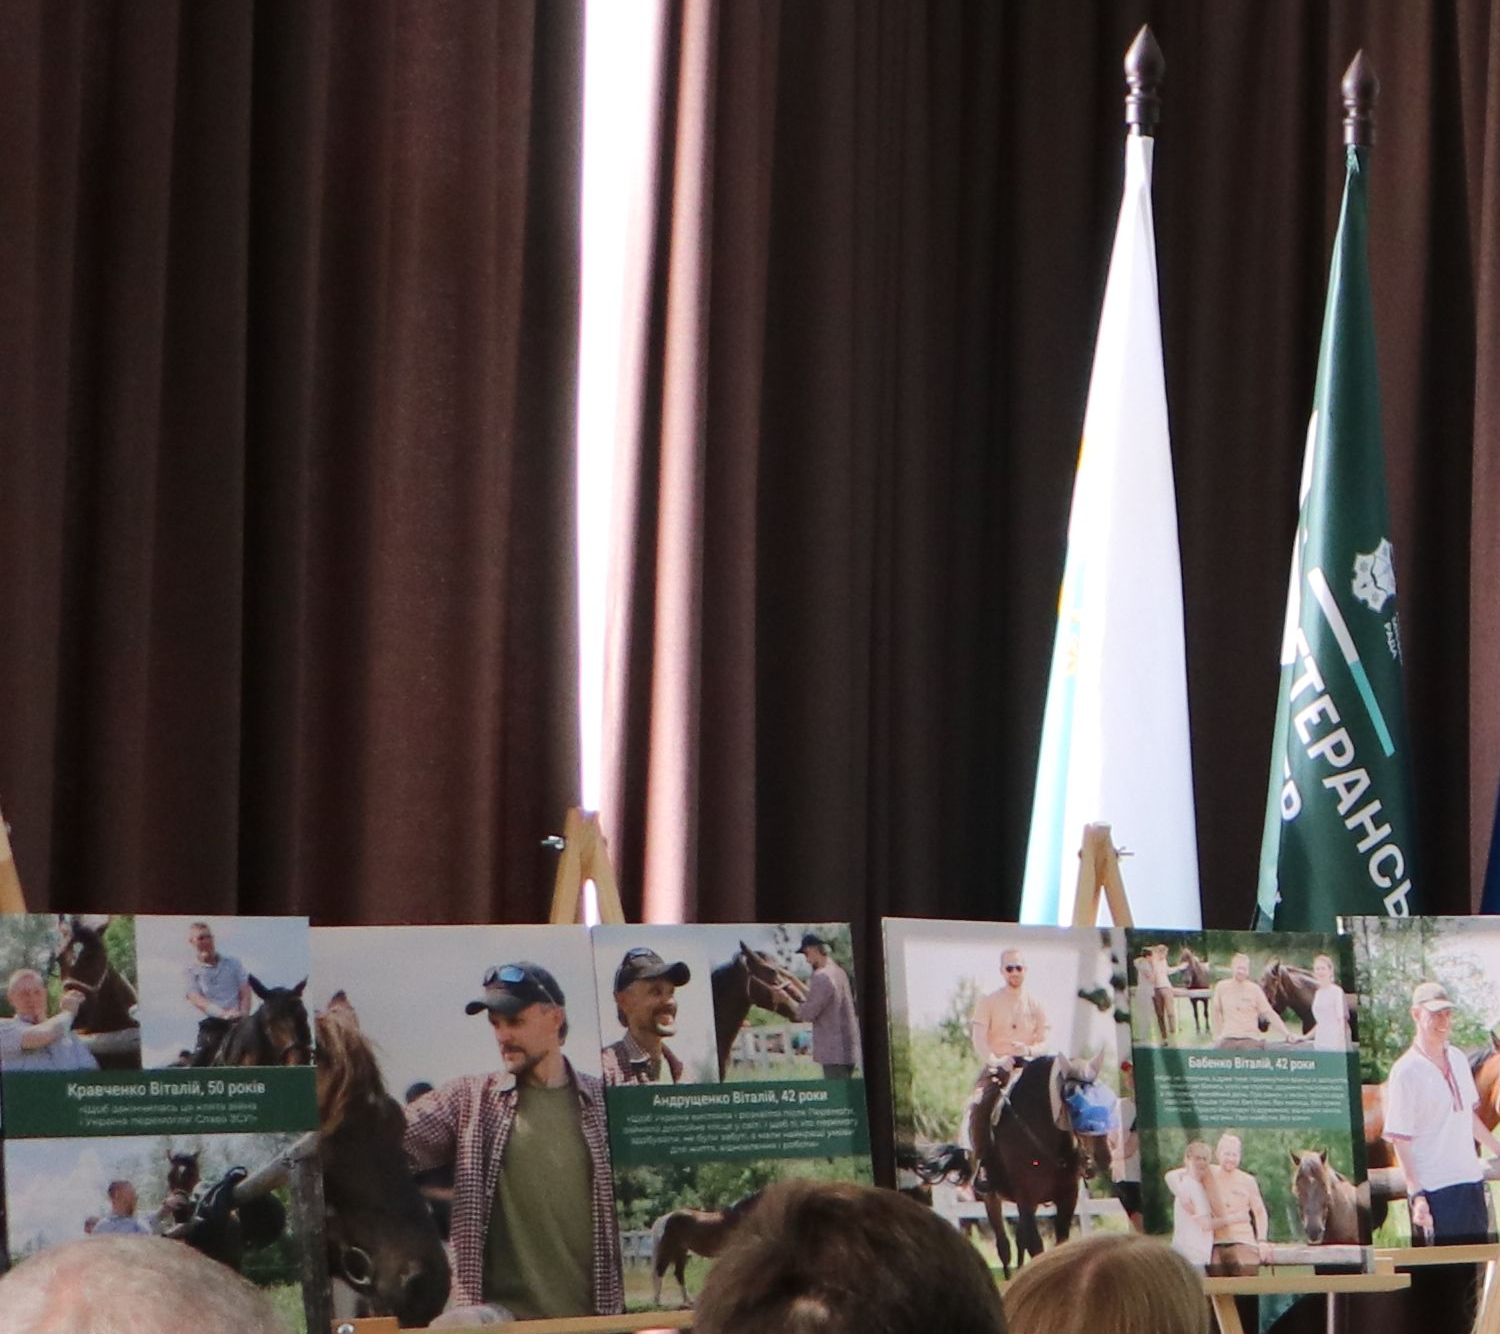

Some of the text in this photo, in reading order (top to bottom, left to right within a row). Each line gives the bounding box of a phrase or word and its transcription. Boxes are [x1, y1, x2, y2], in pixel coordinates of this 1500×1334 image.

[1188, 1056, 1316, 1071] Бабенко Віталій, 42 роки
[66, 1079, 266, 1101] Кравченко Віталій, 50 років
[652, 1089, 828, 1109] Андрущенко Віталій, 42 роки
